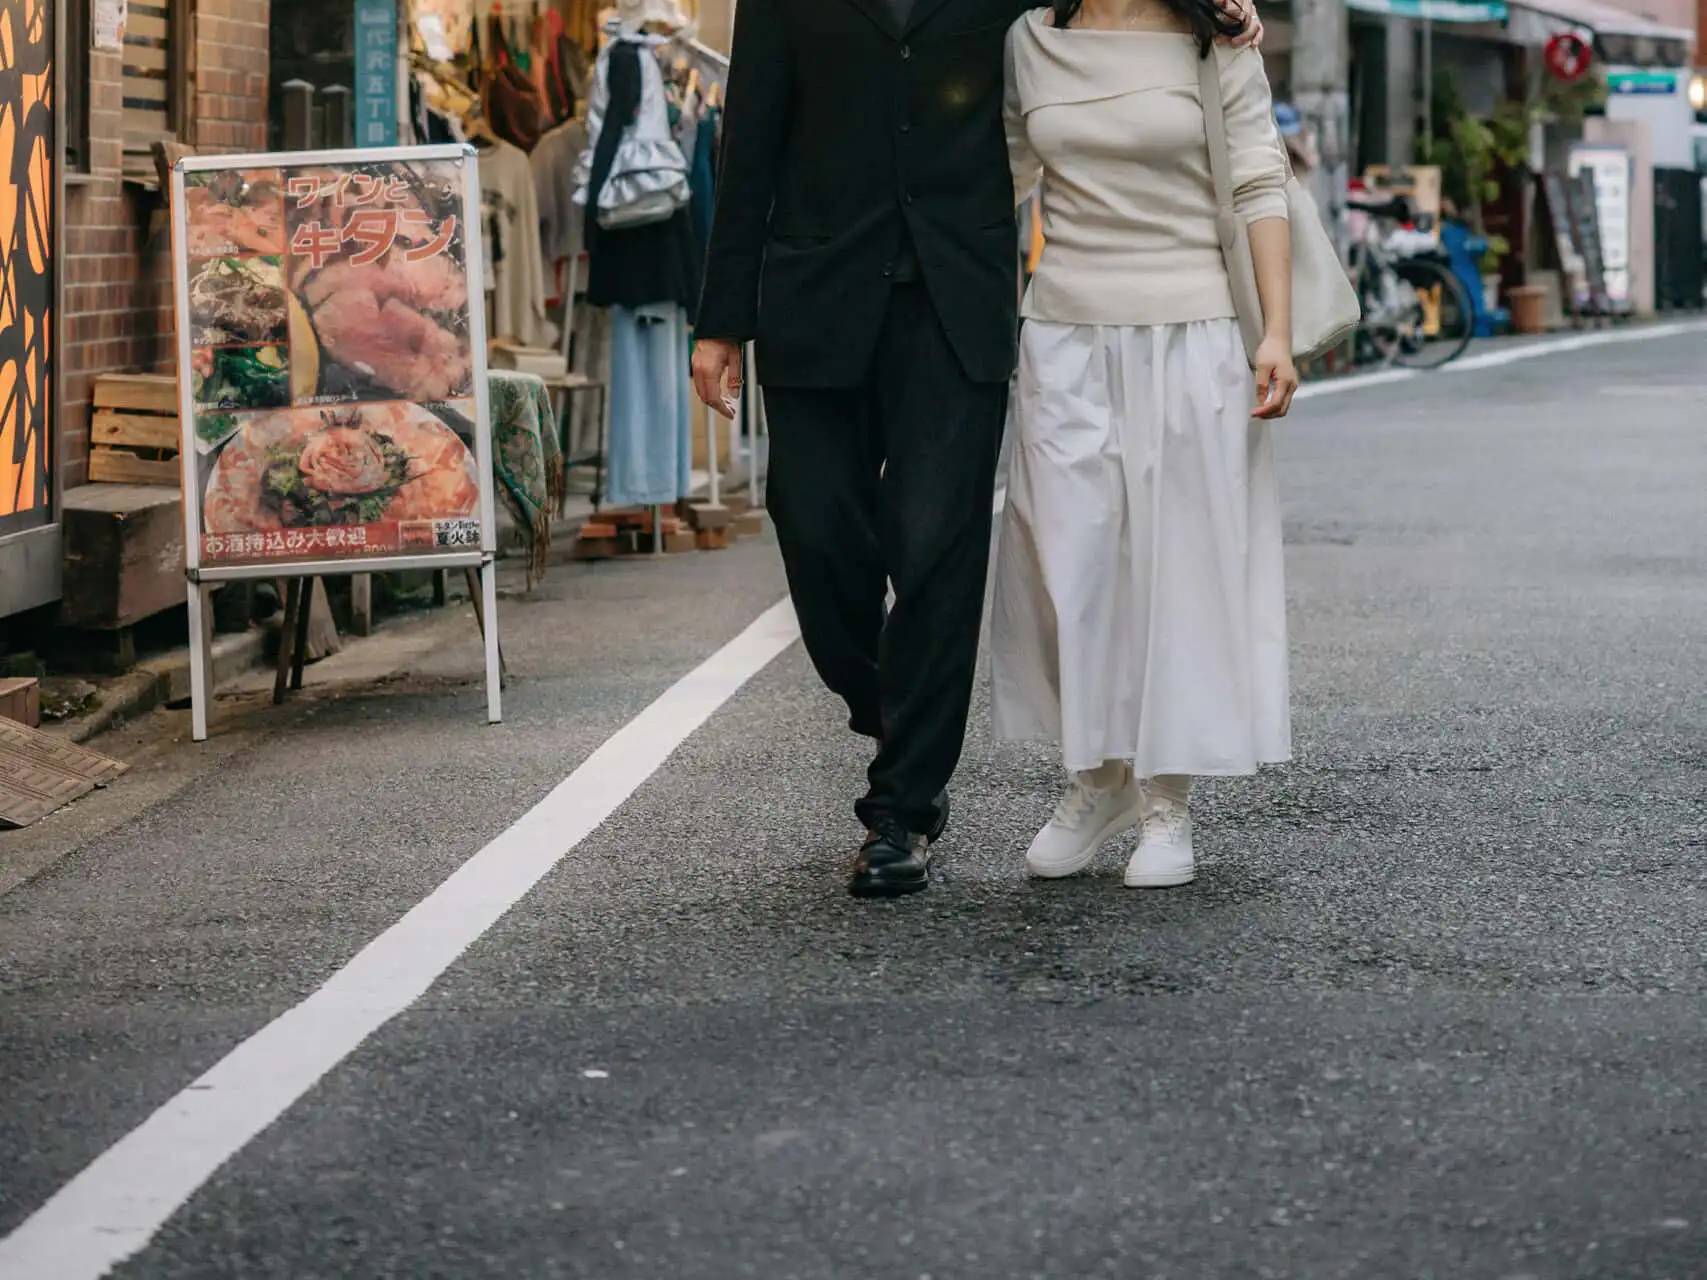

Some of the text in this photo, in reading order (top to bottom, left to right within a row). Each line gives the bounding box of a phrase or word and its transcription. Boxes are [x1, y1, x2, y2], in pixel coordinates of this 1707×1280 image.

[288, 174, 408, 208] ワインと
[291, 208, 457, 268] 牛タン
